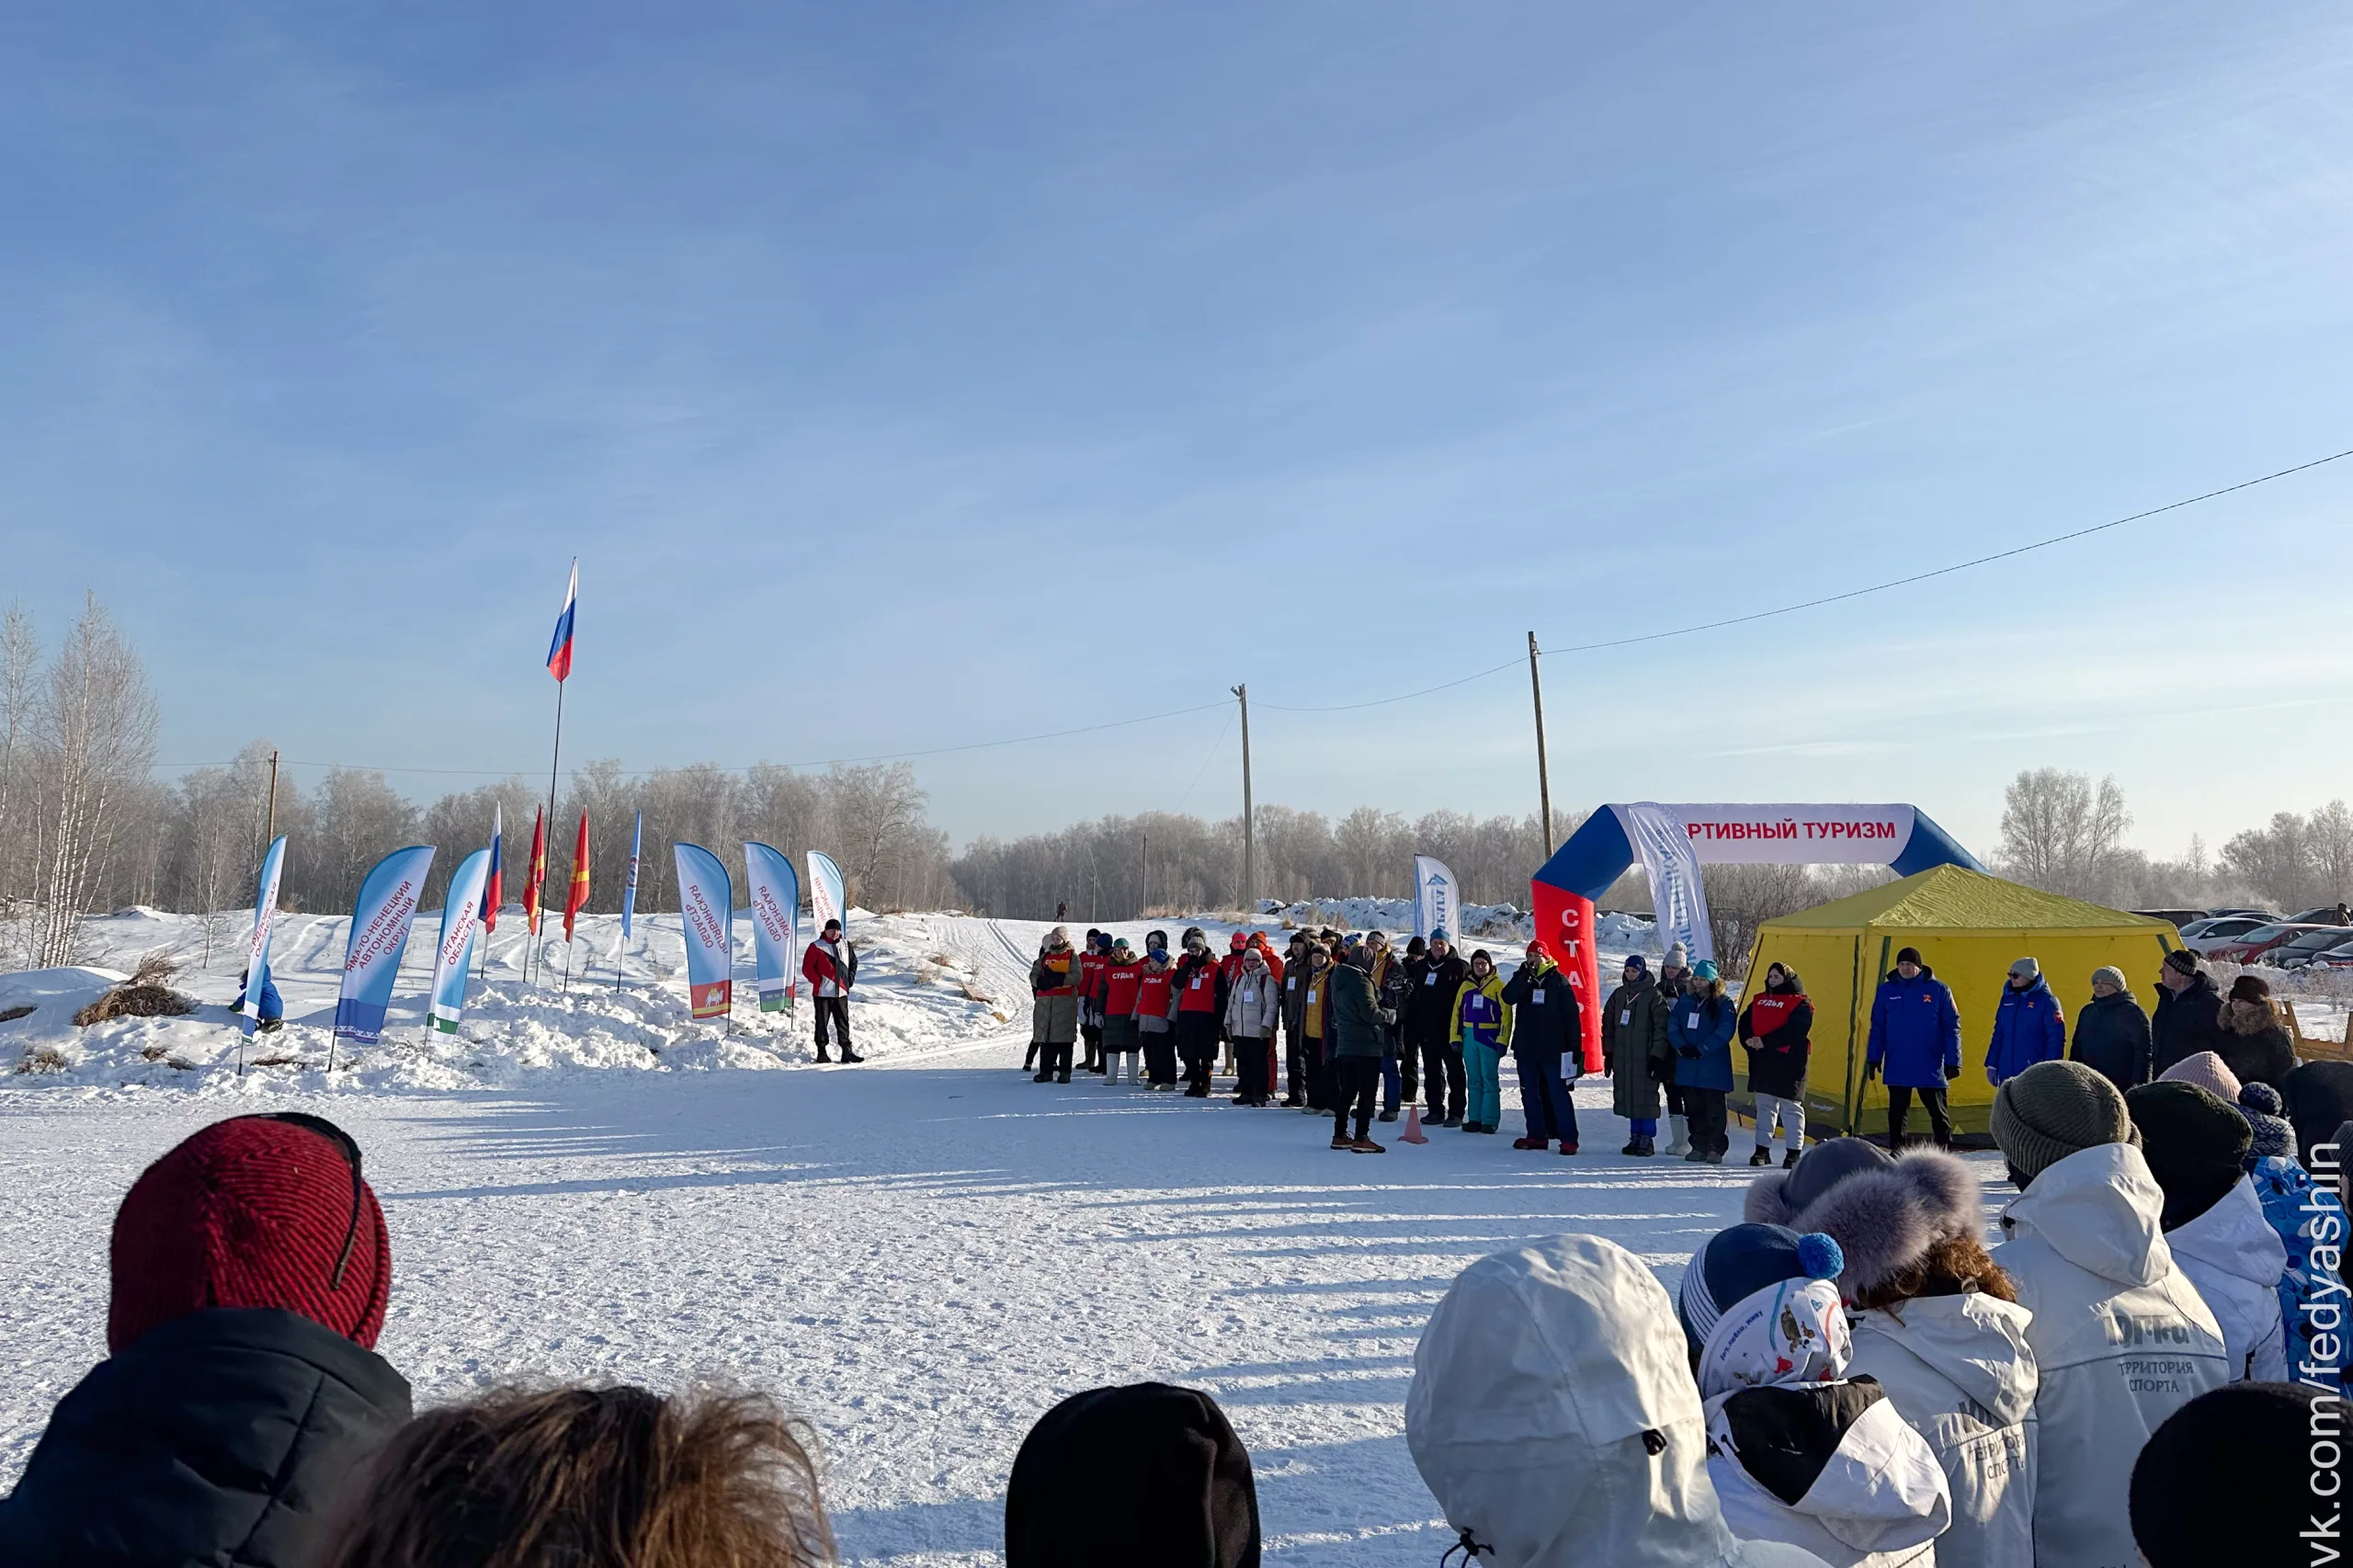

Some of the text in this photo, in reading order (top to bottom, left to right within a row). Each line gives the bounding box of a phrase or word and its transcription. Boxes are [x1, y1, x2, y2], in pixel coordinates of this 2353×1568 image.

[1685, 818, 1896, 840] РТИВНЫЙ ТУРИЗМ
[345, 880, 413, 972] ЯМАЛО-НЕНЕЦКИЙ
[358, 896, 415, 970] АВТОНОМНЫЙ
[382, 922, 409, 956] ОКРУГ
[441, 901, 474, 963] РГАНСКАЯ
[448, 918, 475, 965] ОБЛАСТЬ
[1561, 908, 1586, 1038] СТА
[1756, 999, 1785, 1008] СУДЬЯ
[2129, 1380, 2179, 1392] СПОРТА
